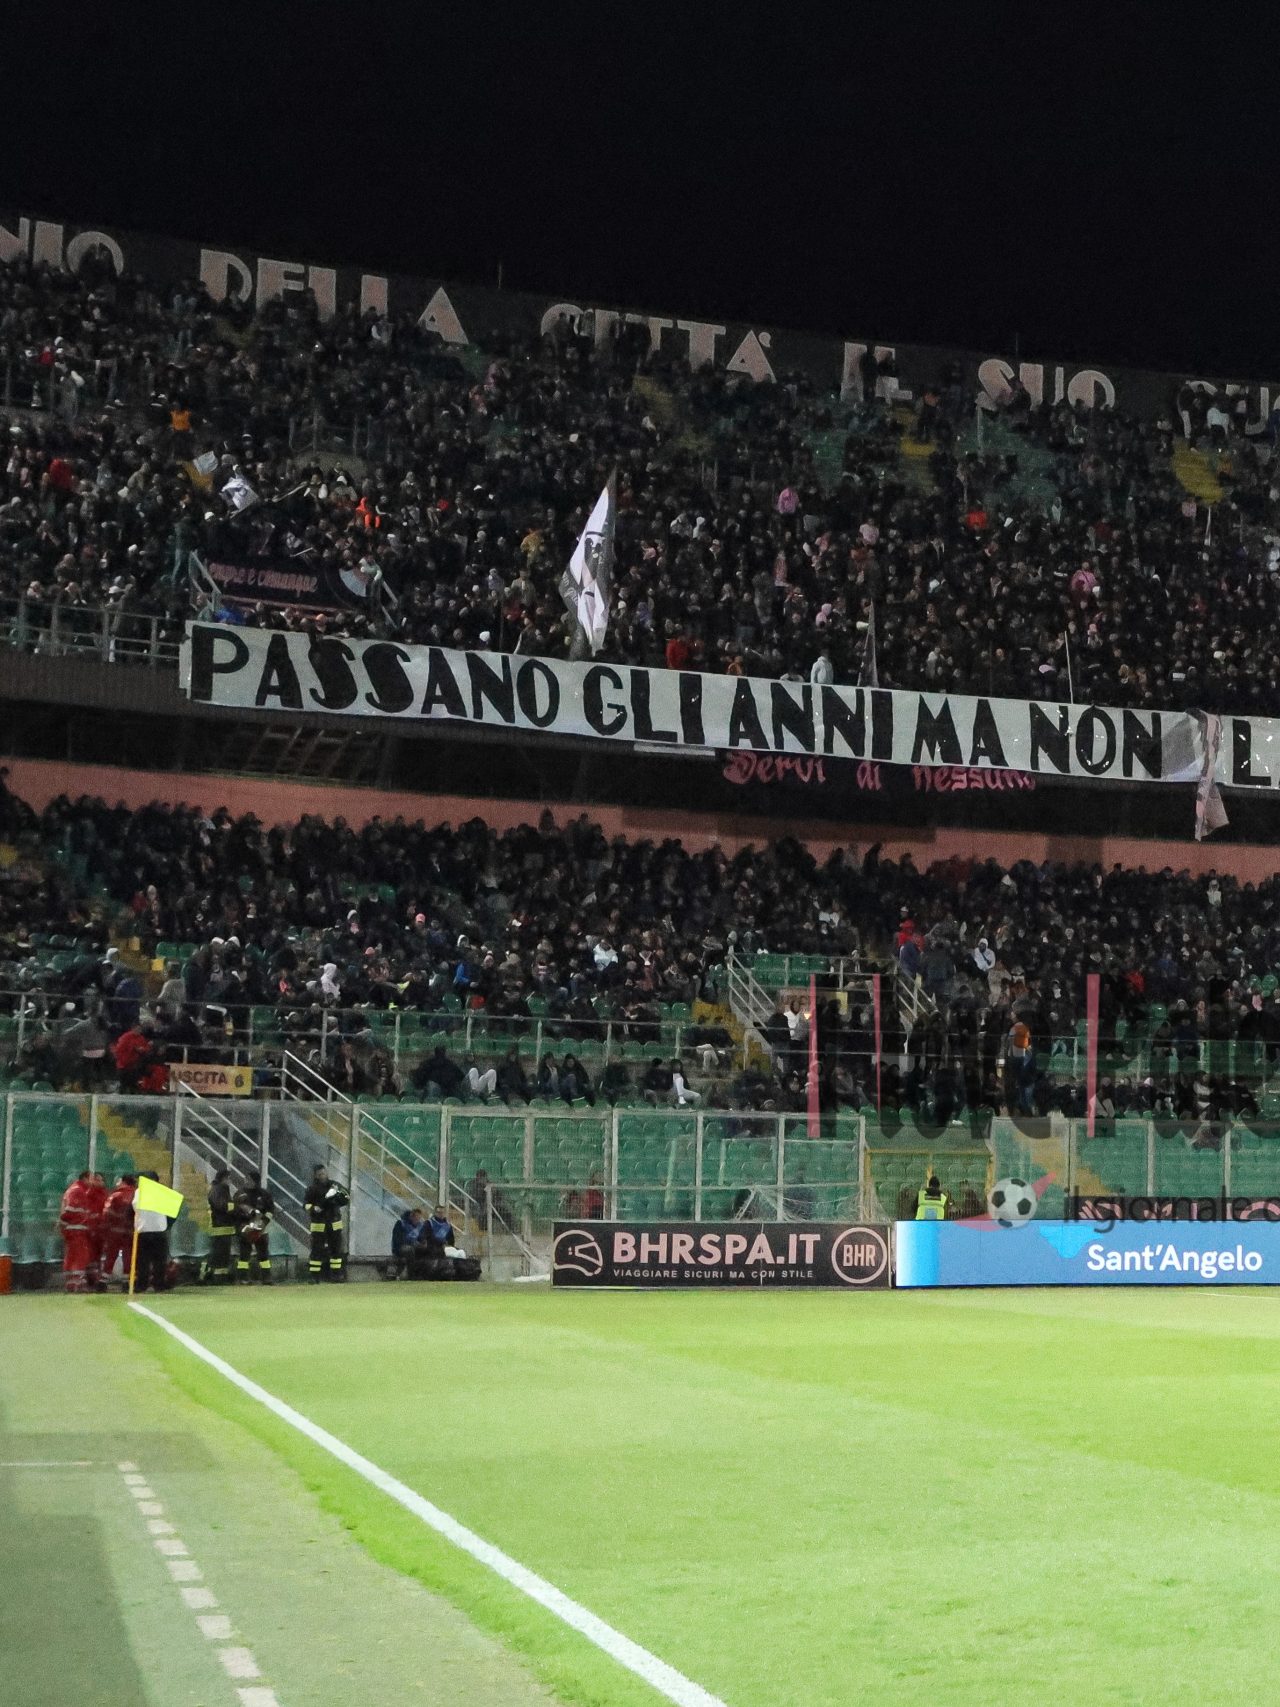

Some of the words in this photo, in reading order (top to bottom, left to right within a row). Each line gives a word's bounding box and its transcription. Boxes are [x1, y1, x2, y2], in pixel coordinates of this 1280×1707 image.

[190, 624, 561, 728] PASSANO
[582, 665, 706, 746] GLI
[729, 678, 893, 761] ANNI
[911, 693, 1009, 768] MA
[1030, 700, 1163, 779] NON
[613, 1231, 821, 1266] BHRSPA.IT
[842, 1245, 876, 1268] BHR
[1087, 1244, 1264, 1279] Sant'Angelo
[613, 1269, 678, 1279] VIAGGIARE
[684, 1269, 724, 1279] SICURI
[729, 1269, 746, 1279] MA
[751, 1269, 776, 1279] CON
[781, 1269, 814, 1279] STILE
